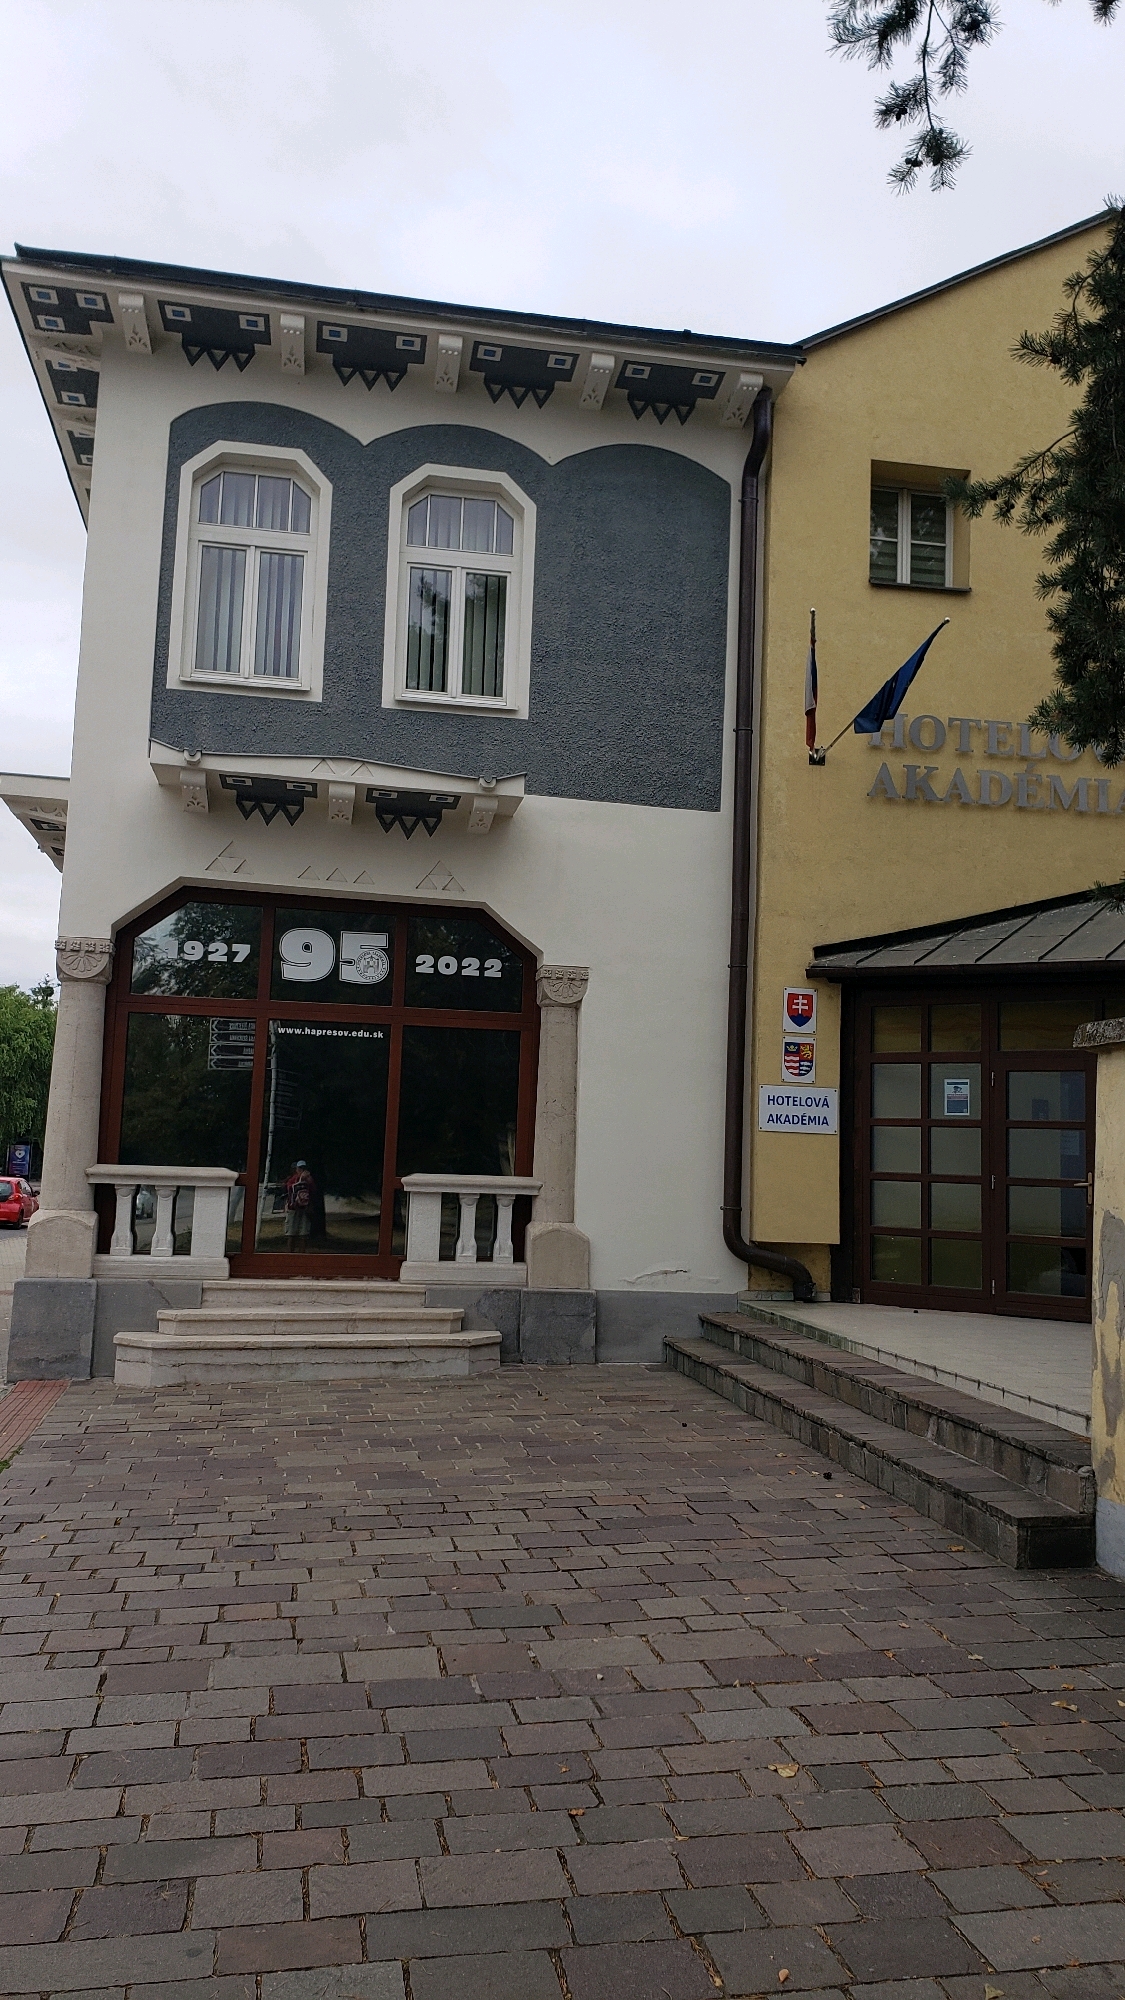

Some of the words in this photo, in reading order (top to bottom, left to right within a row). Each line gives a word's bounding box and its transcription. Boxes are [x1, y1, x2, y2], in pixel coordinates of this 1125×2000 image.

[164, 940, 251, 963] 1927
[279, 927, 390, 985] 95
[415, 954, 502, 978] 2022
[277, 1021, 384, 1039] www.hapresov.edu.sk
[766, 1094, 830, 1109] HOTELOVÁ
[766, 1111, 830, 1127] AKADÉMIA
